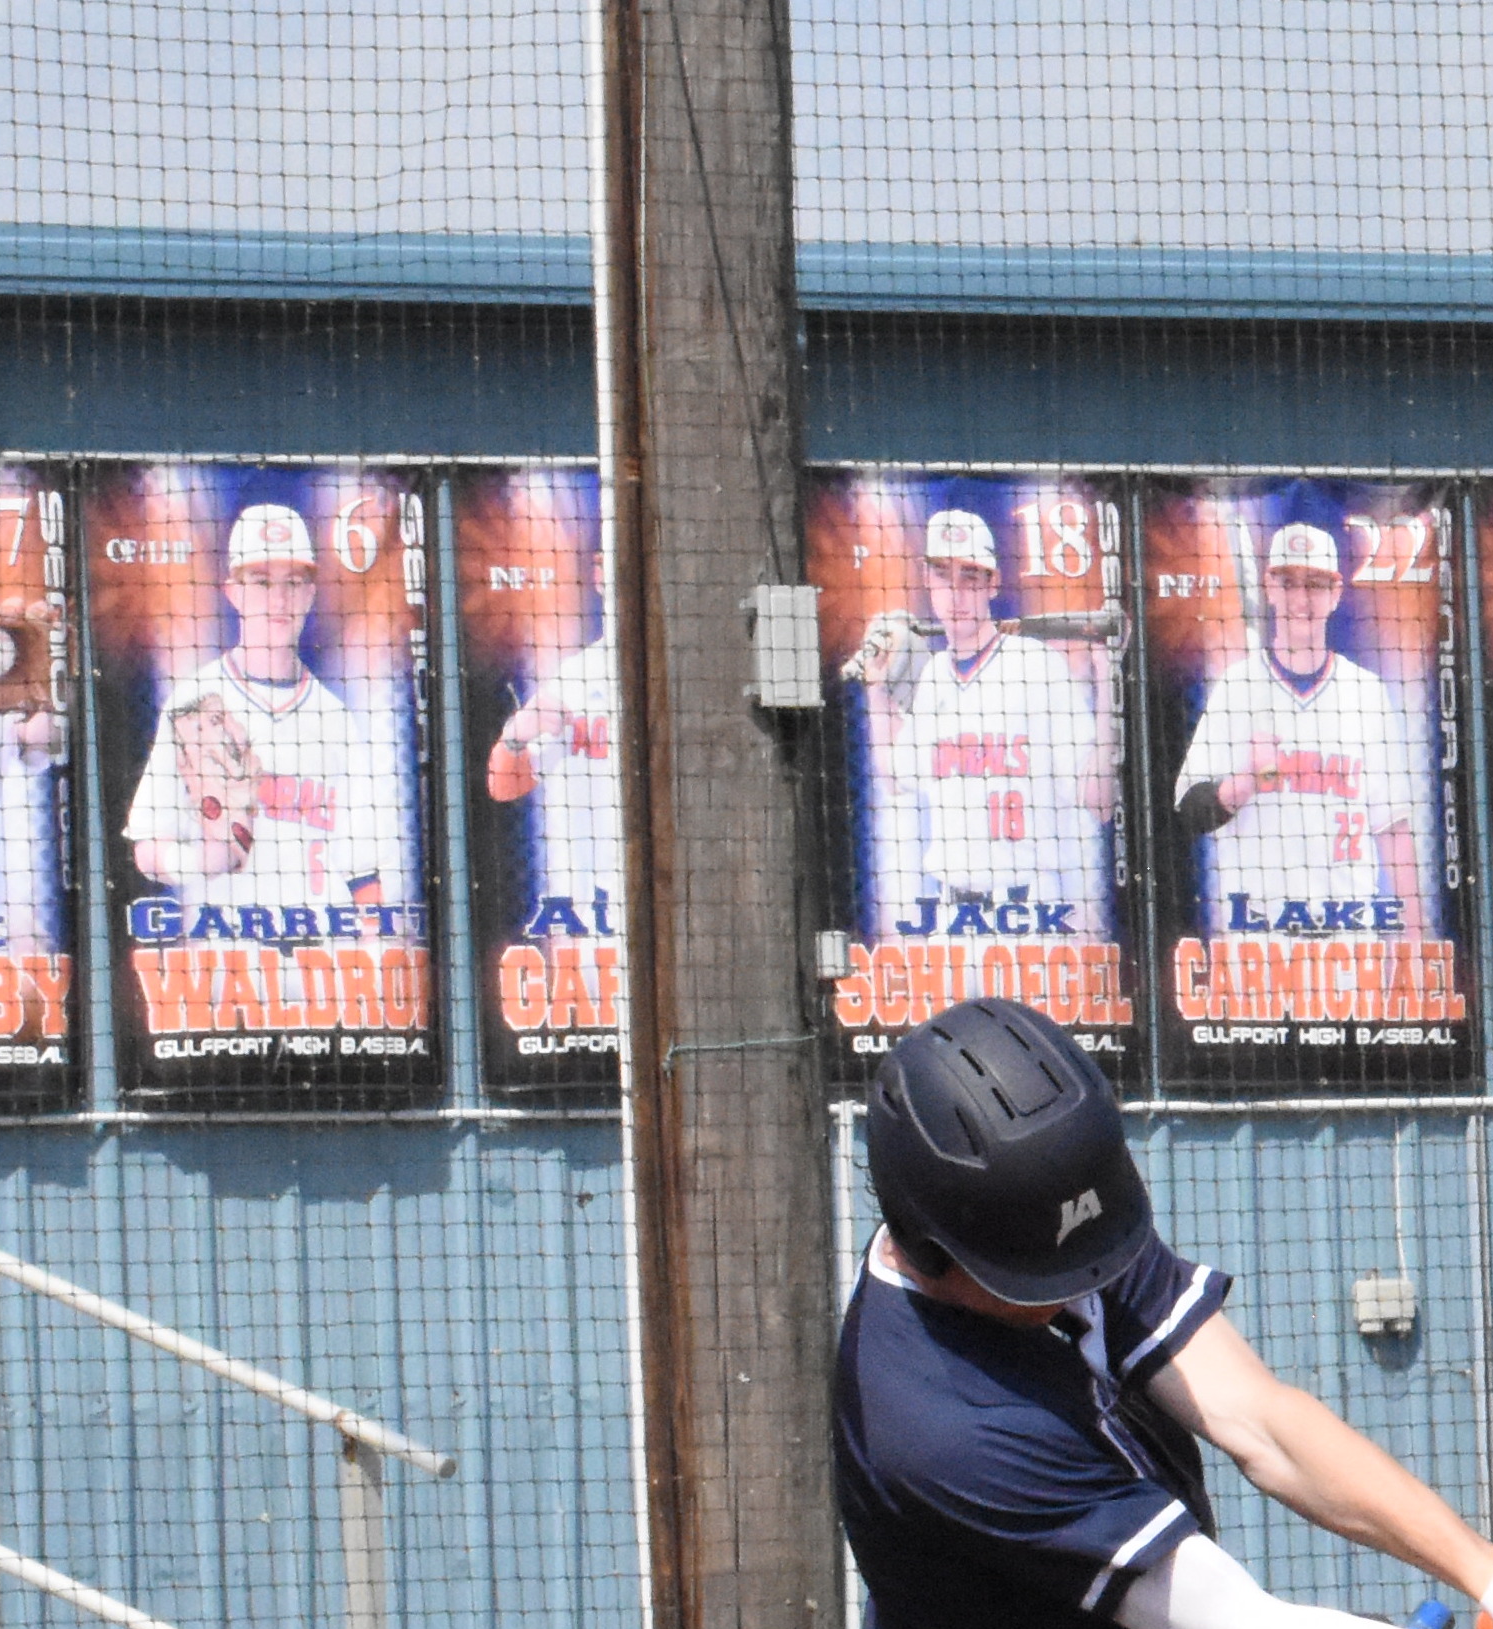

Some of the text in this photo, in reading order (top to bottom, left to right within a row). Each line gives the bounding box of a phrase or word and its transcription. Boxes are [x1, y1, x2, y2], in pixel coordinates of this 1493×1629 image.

[332, 495, 378, 574] 6
[1011, 501, 1094, 580] 18
[1343, 514, 1435, 583] 22
[988, 790, 1026, 843] 18
[1332, 811, 1366, 862] 22
[895, 896, 1079, 937] JACK
[1227, 892, 1406, 933] LAKE
[1174, 937, 1466, 1022] CARMICHAEL
[1298, 1027, 1346, 1045] HIGH
